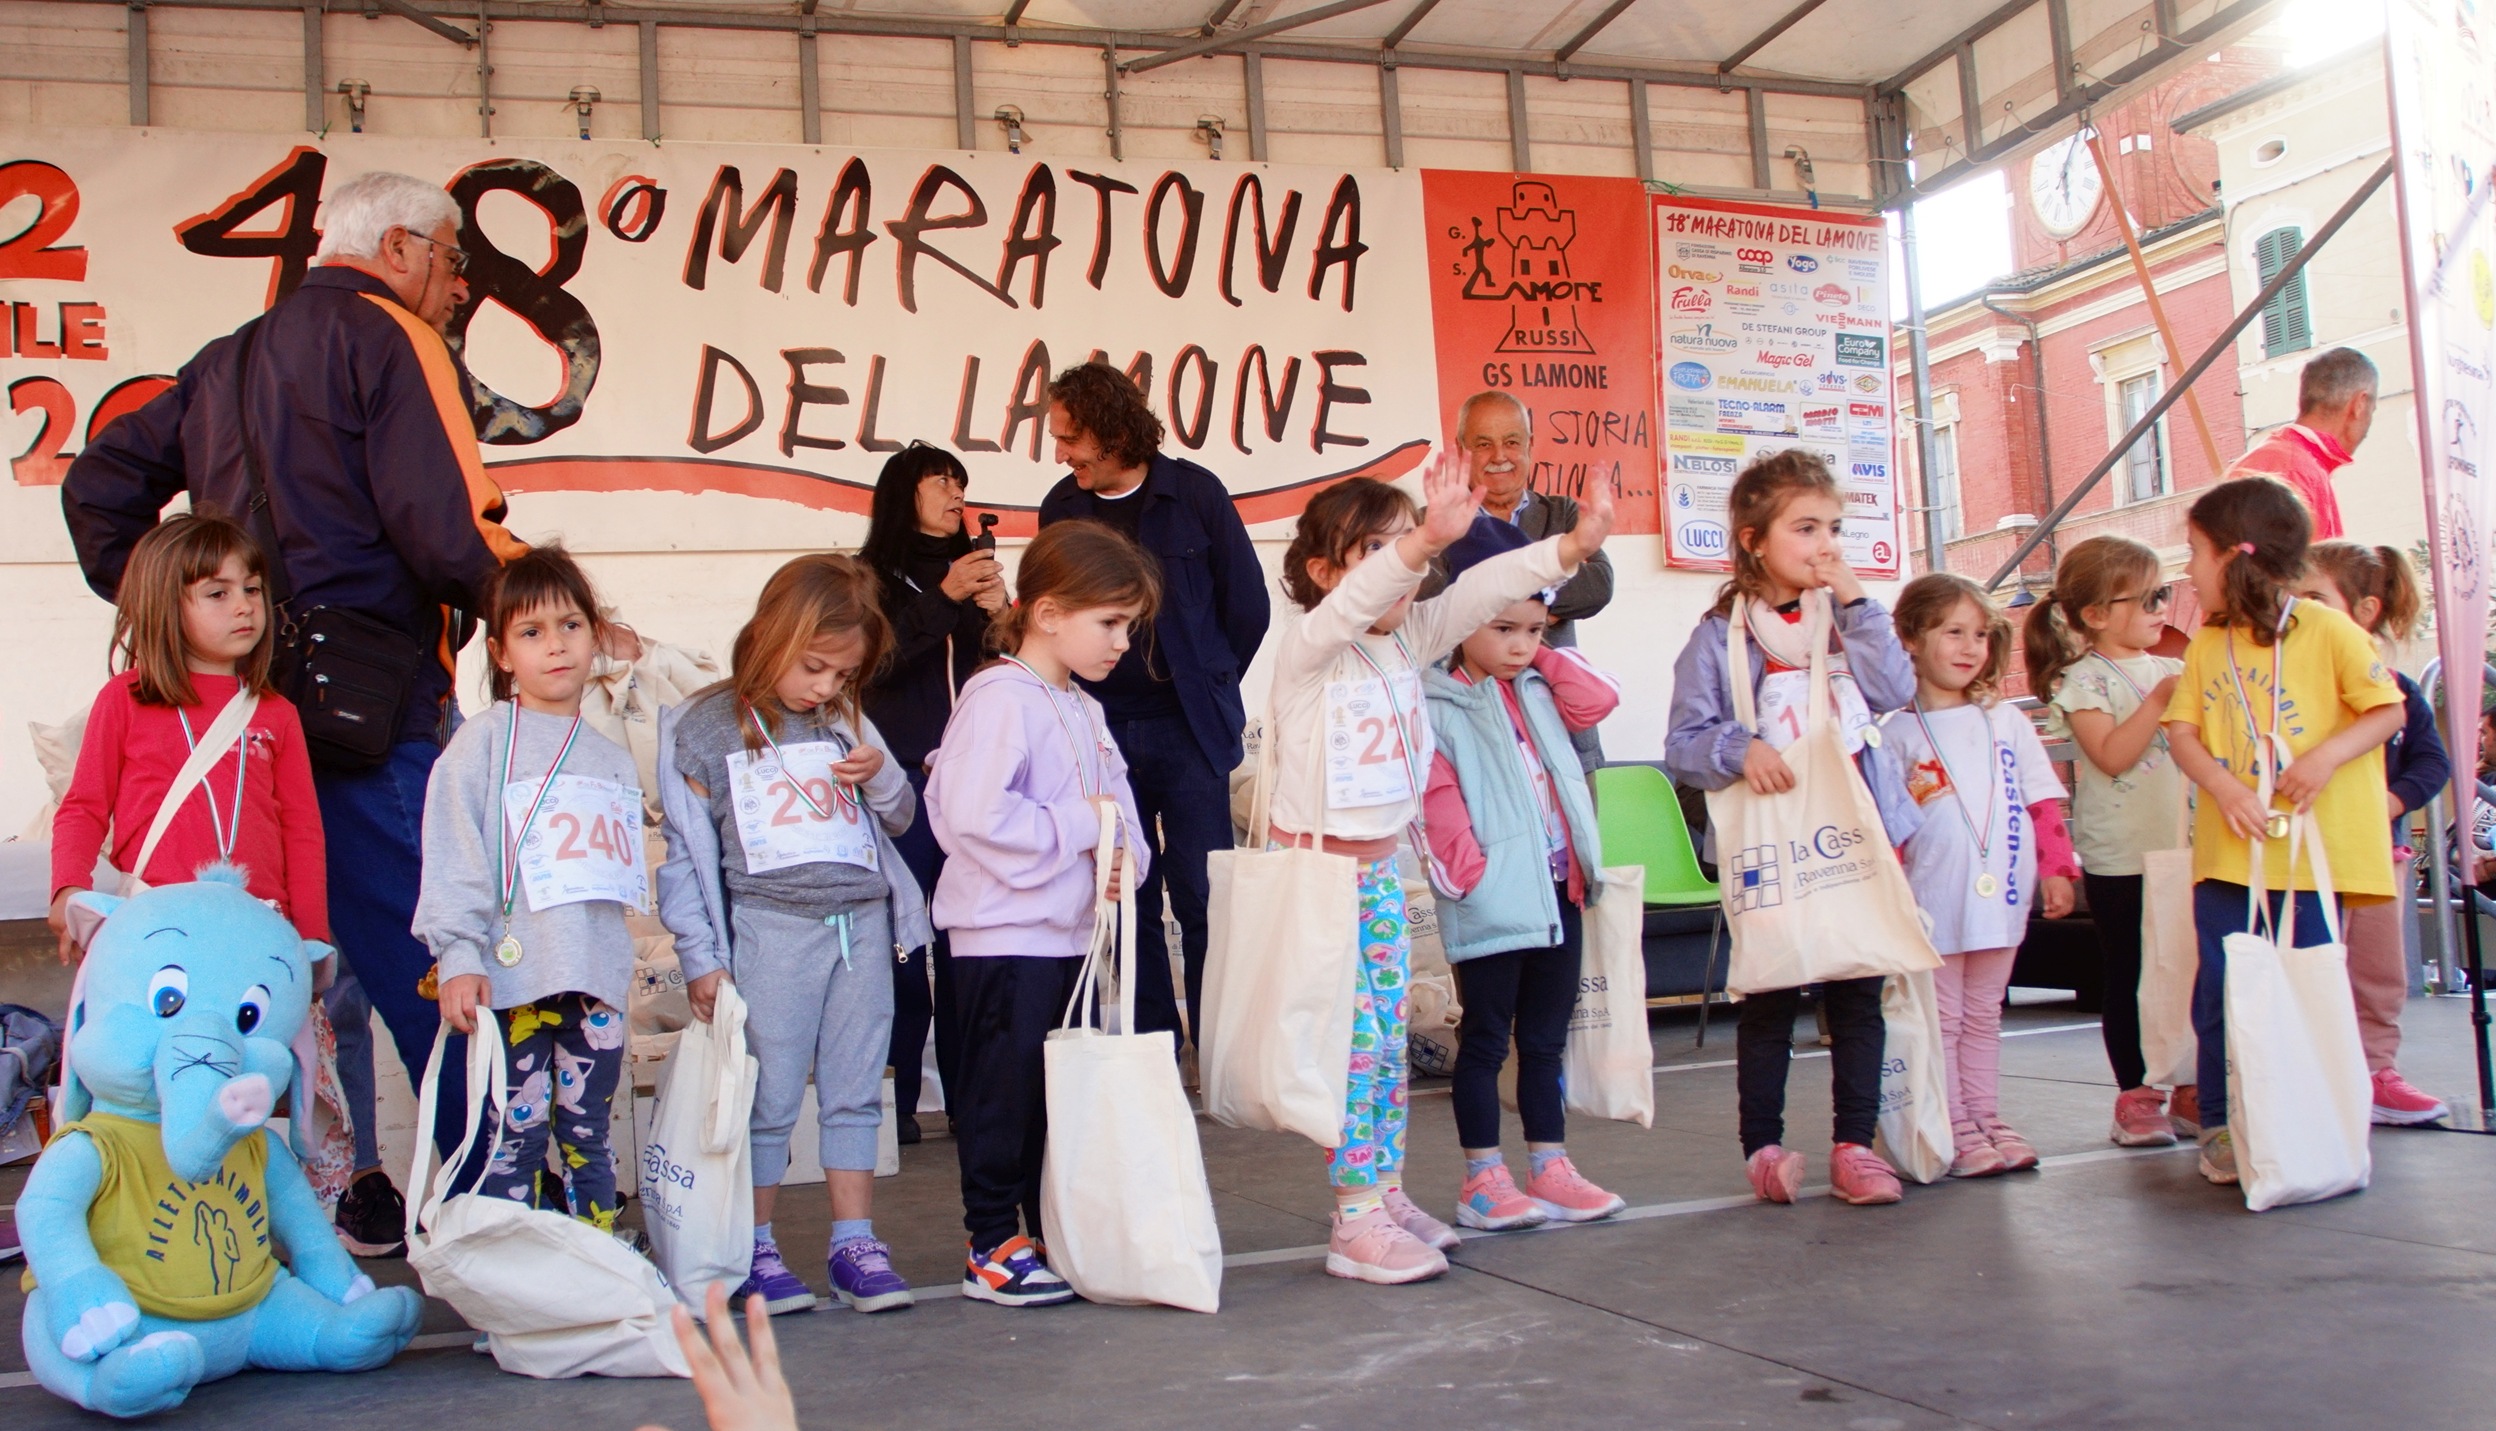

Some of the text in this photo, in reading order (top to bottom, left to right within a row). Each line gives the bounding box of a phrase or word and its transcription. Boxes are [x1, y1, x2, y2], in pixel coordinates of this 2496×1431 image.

[682, 156, 1369, 314] MARATONA
[1691, 215, 1774, 243] MARATONA
[1778, 223, 1811, 245] DEL
[1816, 226, 1879, 252] LAMONE
[1737, 248, 1774, 265] coop
[1788, 255, 1817, 273] Yoga
[1726, 284, 1760, 297] Randi
[1814, 290, 1850, 301] Pineta
[1514, 329, 1578, 347] RUSSI
[1742, 322, 1827, 337] DE STEFANI GROUP
[1670, 334, 1703, 346] natura
[1705, 338, 1738, 348] nuova
[1843, 337, 1865, 348] Euro
[1756, 350, 1815, 368] Magic Gel
[1837, 345, 1880, 359] Company
[1482, 363, 1608, 390] GS LAMONE
[1717, 375, 1795, 393] EMANUELA
[689, 343, 904, 458] DEL
[1549, 410, 1648, 449] STORIA
[1852, 463, 1886, 477] AVIS
[1686, 528, 1724, 549] LUCCI
[549, 812, 633, 867] 240
[1813, 825, 1866, 859] Cass
[1797, 861, 1858, 887] Ravenna
